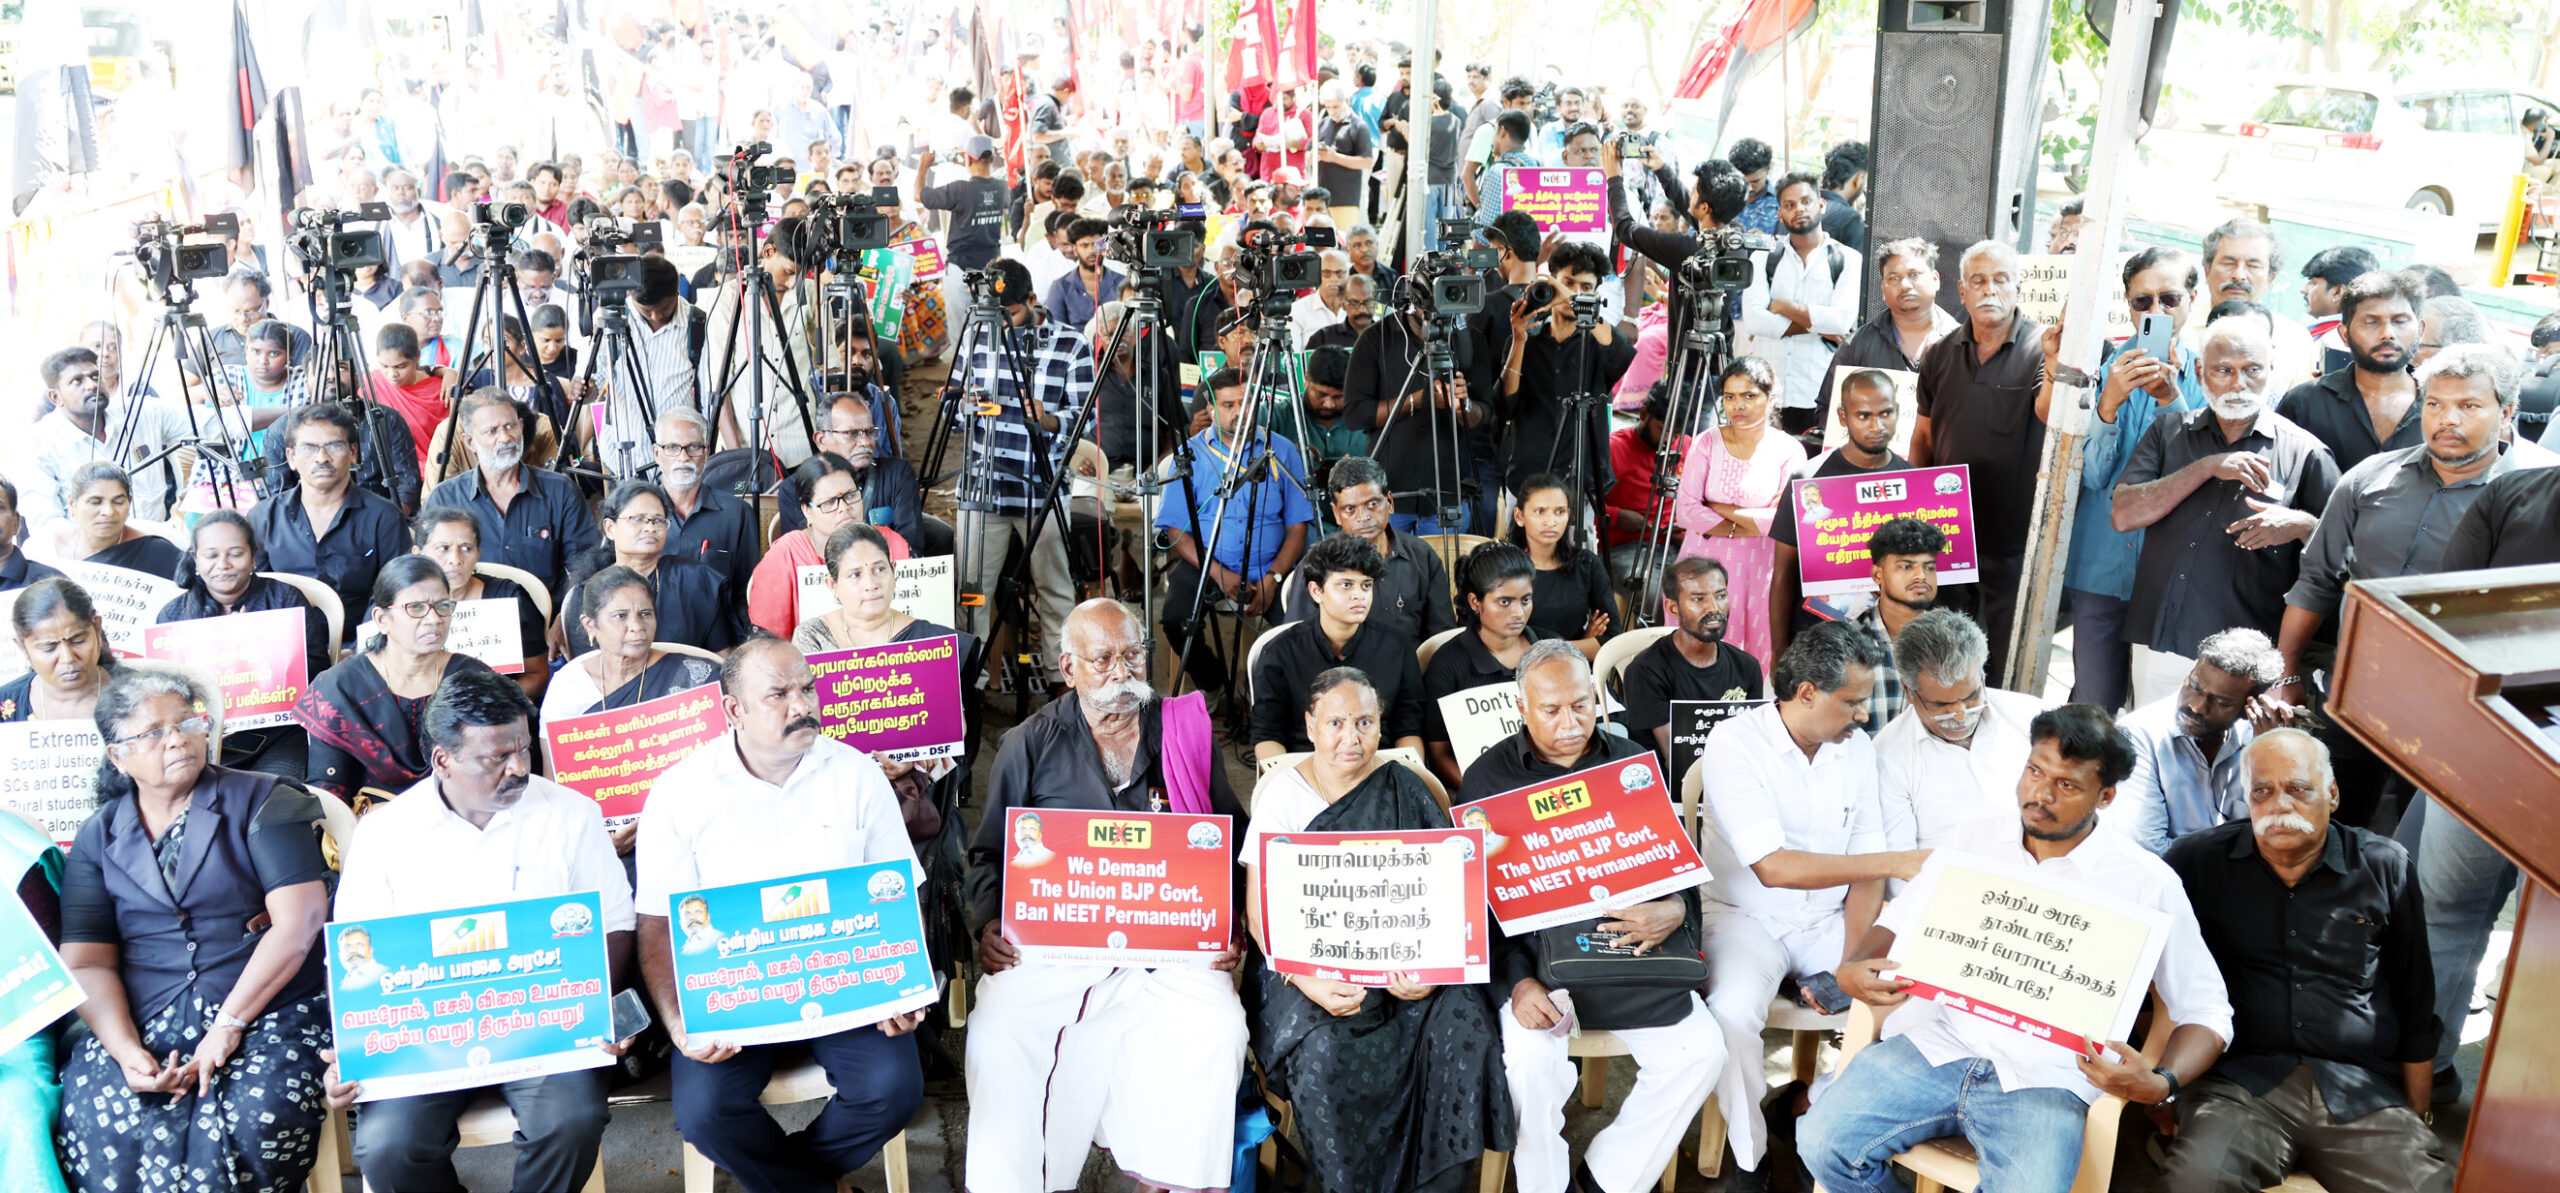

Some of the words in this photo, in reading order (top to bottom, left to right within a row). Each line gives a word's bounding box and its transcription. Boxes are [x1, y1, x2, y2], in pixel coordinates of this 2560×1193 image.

[1861, 484, 1902, 499] NEET
[1815, 517, 1849, 532] சமூக
[832, 669, 912, 697] புற்றெடுக்க
[822, 687, 925, 719] கருநாகங்கள்
[1465, 692, 1512, 715] Don't
[275, 711, 293, 722] DS
[29, 731, 99, 749] Extreme
[557, 723, 611, 744] எங்கள்
[11, 757, 50, 771] Social
[54, 755, 99, 769] Justice
[930, 745, 950, 755] DSF
[3, 779, 29, 793] SCs
[34, 777, 57, 790] and
[62, 775, 88, 789] BCs
[1534, 788, 1583, 814] NEET
[1094, 826, 1146, 843] NEET
[1522, 832, 1549, 851] We
[1550, 812, 1616, 845] Demand
[1298, 847, 1431, 871] பாராமெடிக்கல்
[1497, 860, 1530, 880] The
[1531, 847, 1580, 870] Union
[1579, 836, 1613, 859] BJP
[1616, 825, 1659, 848] Govt.
[1068, 856, 1093, 875] We
[1098, 857, 1166, 878] Demand
[1494, 881, 1529, 902] Ban
[1529, 869, 1574, 894] NEET
[1576, 840, 1681, 884] Permanently!
[1030, 879, 1062, 898] The
[1067, 880, 1115, 900] Union
[1121, 882, 1154, 901] BJP
[1159, 884, 1203, 903] Govt.
[1303, 877, 1427, 903] படிப்புகளிலும்
[1015, 902, 1047, 921] Ban
[1053, 903, 1100, 923] NEET
[1105, 905, 1216, 931] Permanently!
[1343, 907, 1431, 932] தேர்வைத்
[1981, 889, 2040, 914] ஒன்றிய
[2043, 907, 2092, 932] அரசே
[717, 930, 775, 957] ஒன்றிய
[779, 920, 827, 944] பாஜக
[830, 911, 881, 937] அரசே!
[1924, 925, 1989, 953] மாணவர்
[1310, 938, 1422, 962] திணிக்காதே!
[380, 962, 445, 993] ஒன்றிய
[449, 955, 503, 980] பாஜக
[506, 946, 562, 973] அரசே!
[685, 962, 763, 992] பெட்ரோல்,
[767, 954, 802, 977] டீசல்
[805, 950, 850, 972] விலை
[853, 940, 919, 964] உயர்வை
[706, 988, 759, 1014] திரும்ப
[762, 980, 806, 1004] பெறு!
[809, 972, 861, 997] திரும்ப
[863, 963, 906, 985] பெறு!
[341, 997, 430, 1030] பெட்ரோல்,
[434, 992, 473, 1017] டீசல்
[476, 988, 526, 1011] விலை
[528, 977, 600, 1003] உயர்வை
[364, 1026, 425, 1056] திரும்ப
[426, 1018, 476, 1047] பெறு!
[477, 1010, 536, 1040] திரும்ப
[537, 1003, 585, 1031] பெறு!
